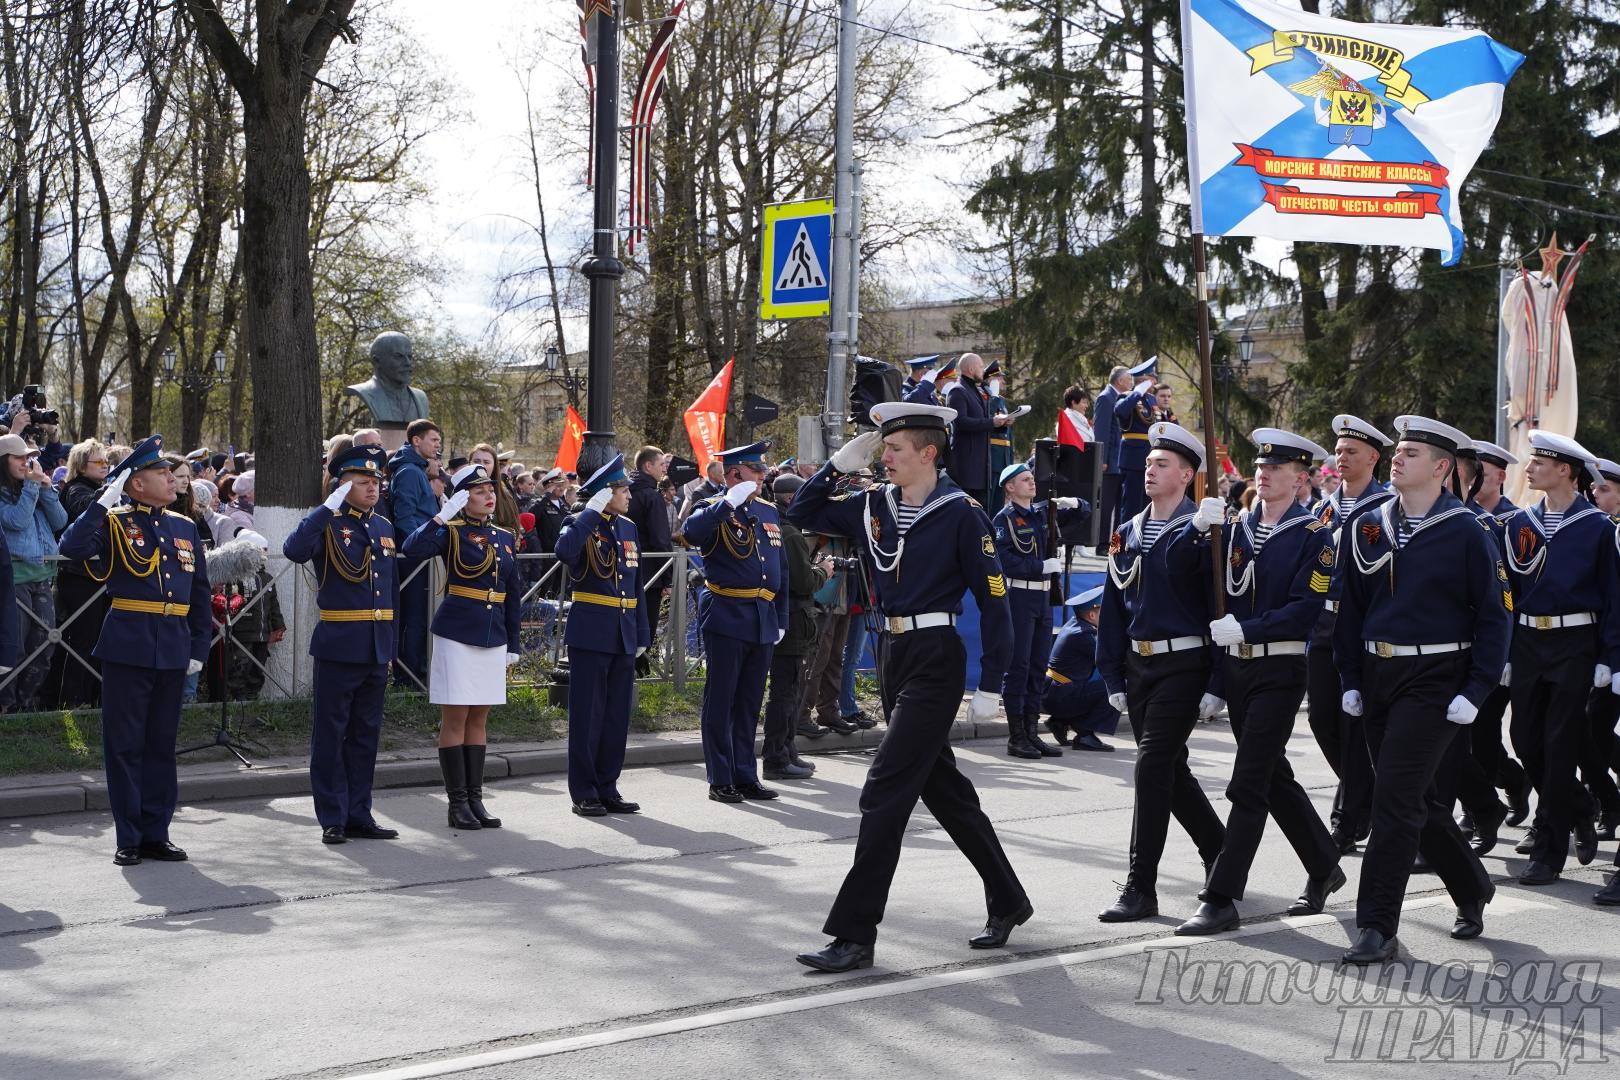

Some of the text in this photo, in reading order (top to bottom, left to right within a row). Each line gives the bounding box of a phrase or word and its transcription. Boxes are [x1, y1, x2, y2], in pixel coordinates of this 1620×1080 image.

[1289, 33, 1399, 71] ТЧИНСКИЕ
[1265, 160, 1432, 182] МОРСКИЕ КАДЕТСКИЕ КЛАССЫ
[1280, 196, 1419, 214] ОТЕЧЕСТВО! ЧЕСТЬ! ФЛОТ!
